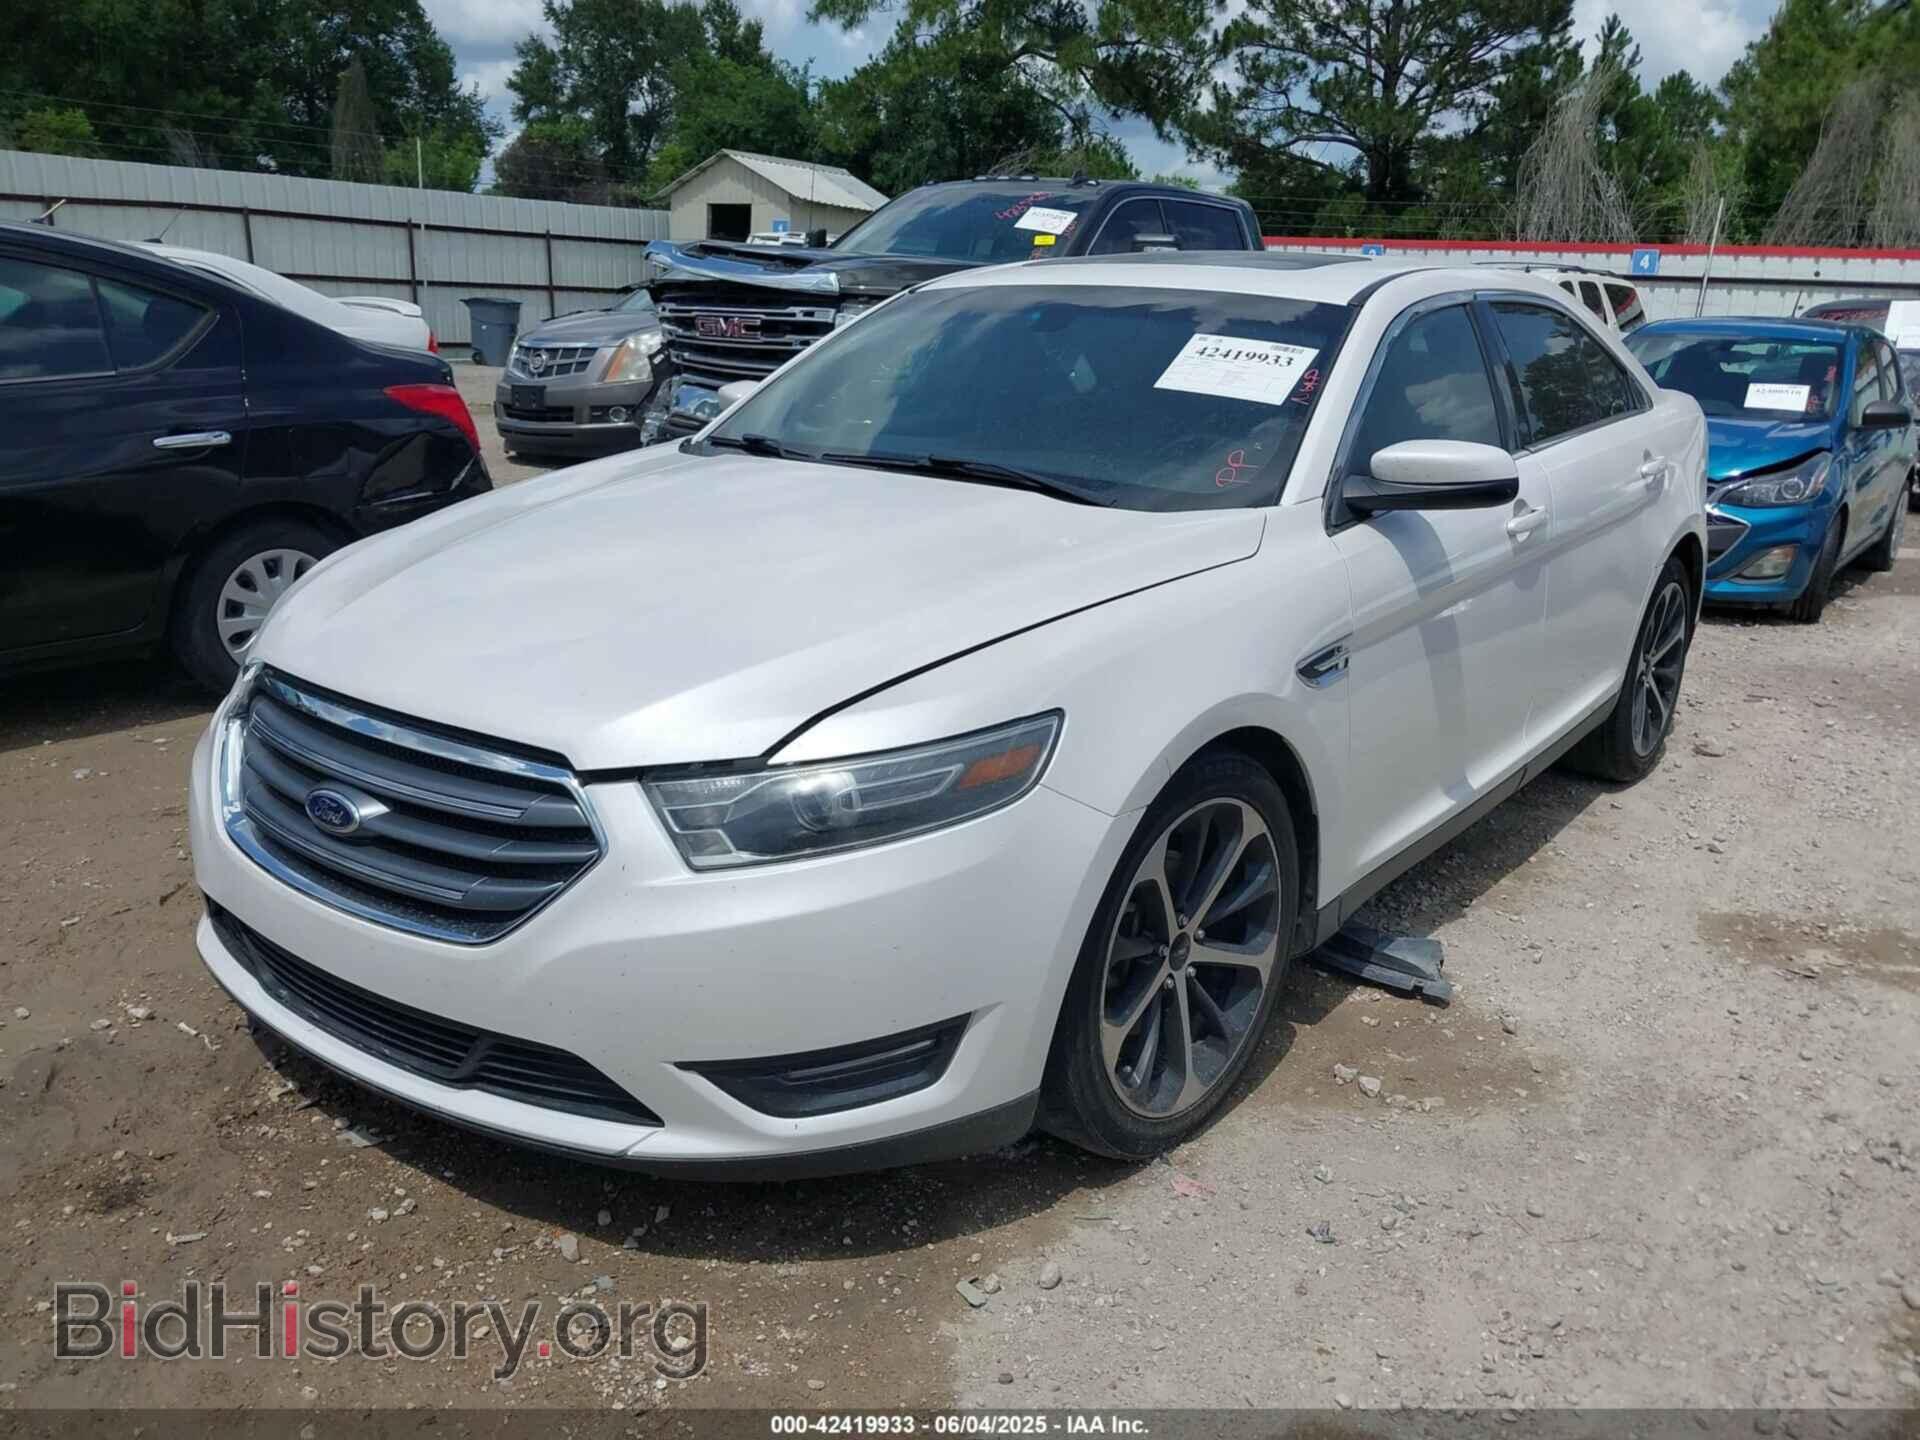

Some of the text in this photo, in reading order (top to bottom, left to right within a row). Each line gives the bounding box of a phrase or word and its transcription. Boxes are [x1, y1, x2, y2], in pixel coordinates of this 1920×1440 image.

[1640, 254, 1650, 270] 4
[695, 317, 761, 339] GMC
[1194, 346, 1294, 368] 42419933
[314, 797, 345, 825] Ford
